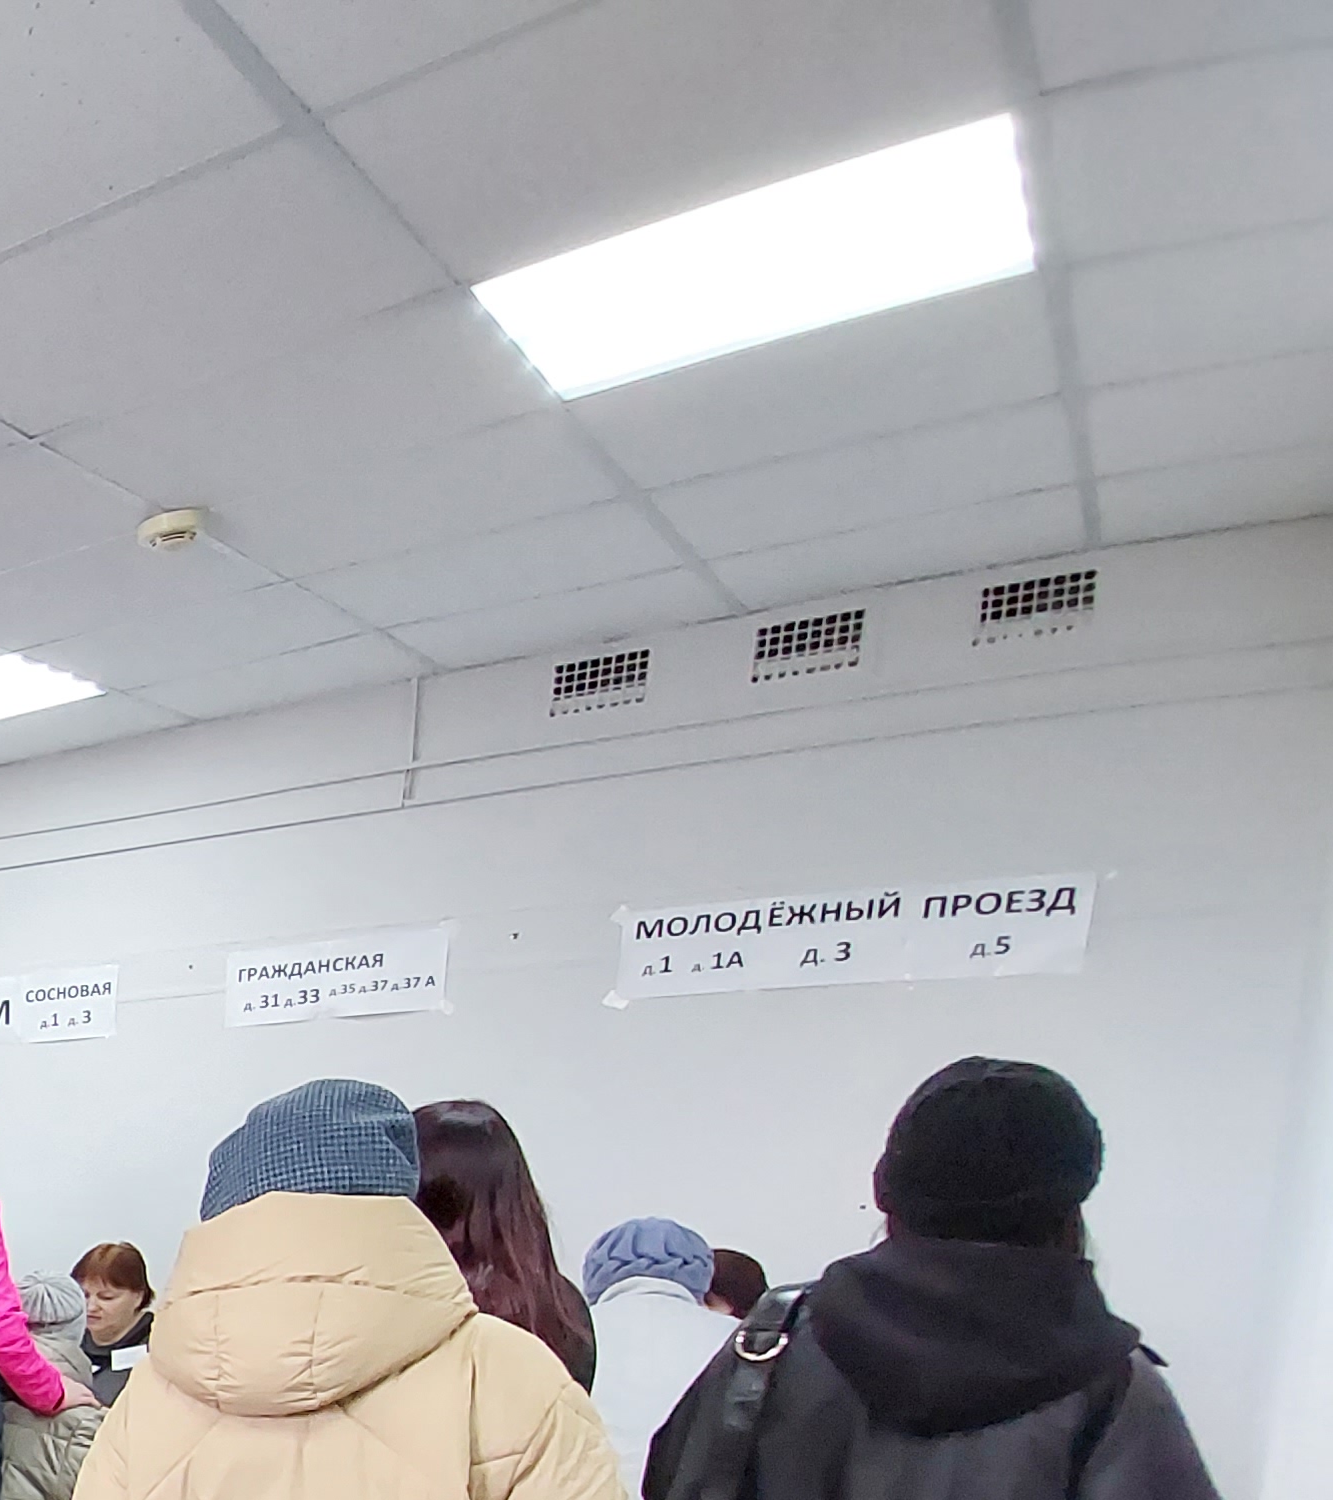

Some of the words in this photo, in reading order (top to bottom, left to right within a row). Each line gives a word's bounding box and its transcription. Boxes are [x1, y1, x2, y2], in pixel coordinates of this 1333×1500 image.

[635, 890, 901, 940] МОЛОДЁЖНЫЙ
[922, 886, 1077, 919] ПРОЕЗД
[238, 953, 384, 983] ГРАЖДАНСКАЯ
[25, 981, 112, 1003] СОСНОВАЯ
